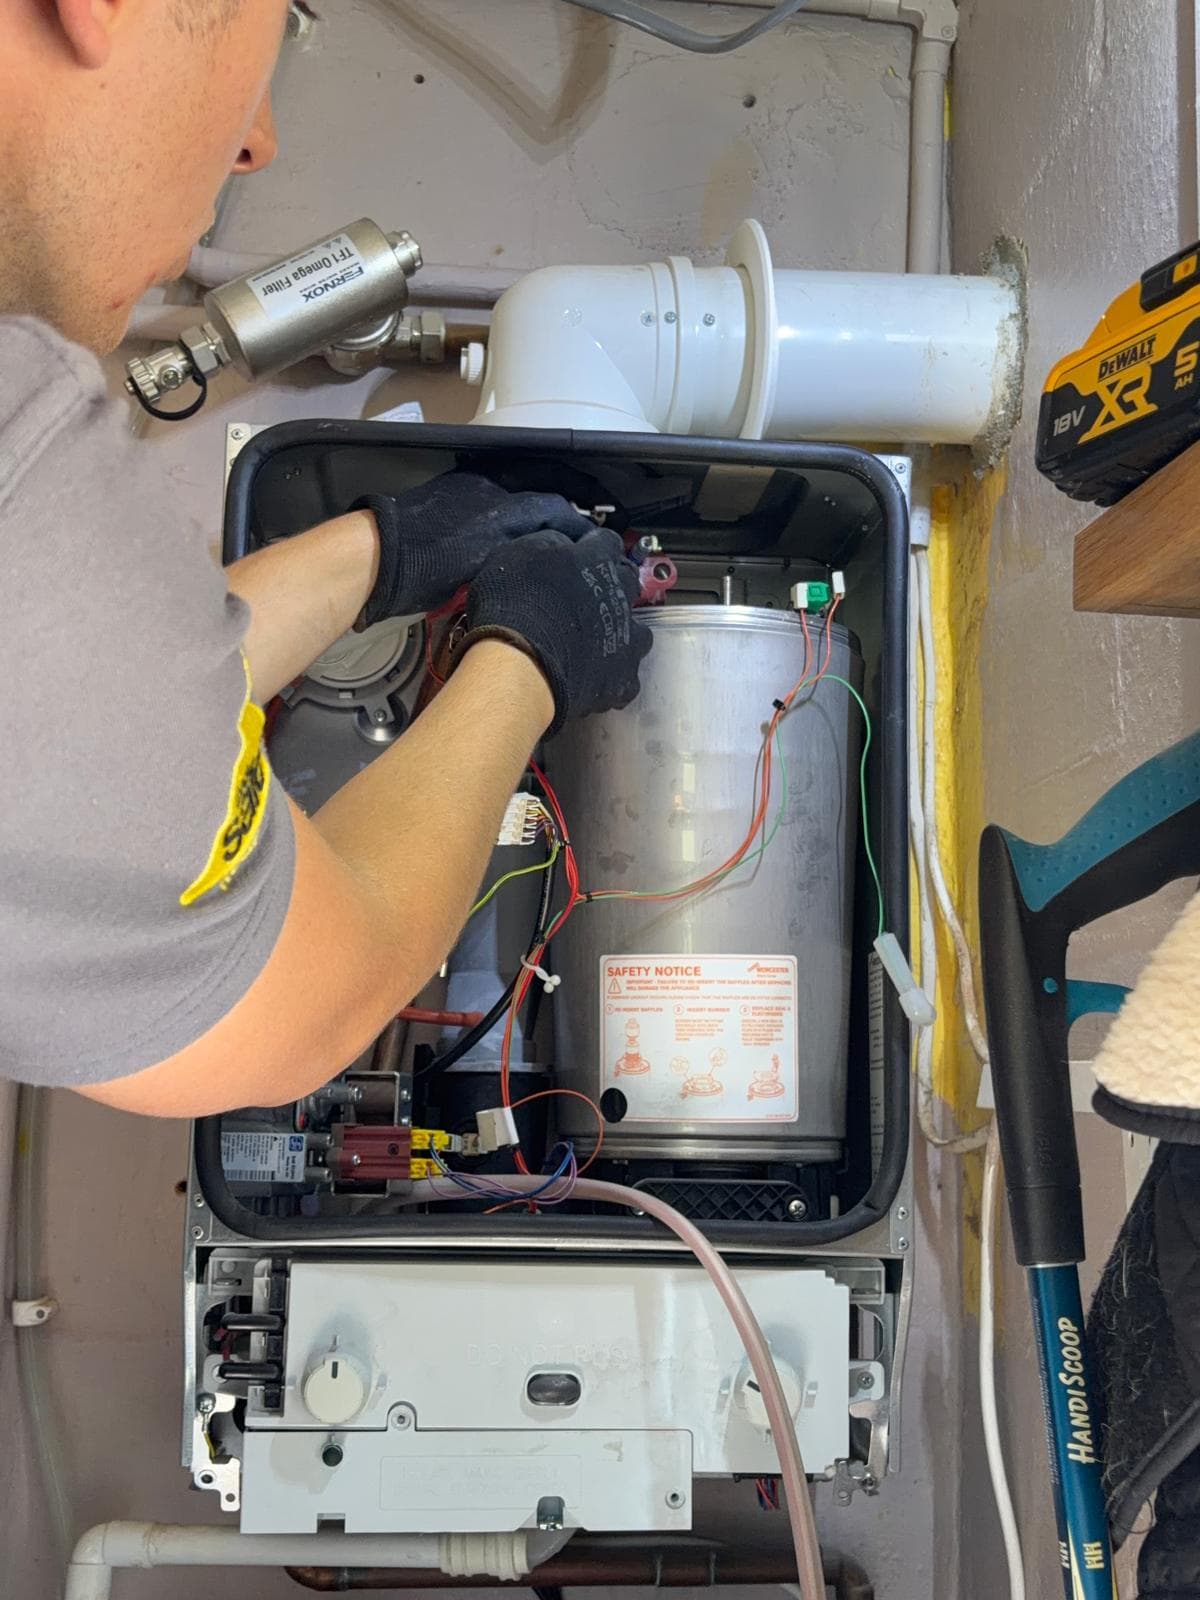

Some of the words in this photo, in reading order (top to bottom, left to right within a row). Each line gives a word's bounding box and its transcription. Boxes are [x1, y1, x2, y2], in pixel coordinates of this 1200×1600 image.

[333, 247, 355, 264] TF1
[292, 258, 333, 281] Omega
[262, 278, 293, 296] Filter
[302, 266, 364, 302] FERNOX
[1175, 341, 1200, 377] 5
[1174, 373, 1194, 391] AH
[1077, 366, 1159, 445] XR
[1052, 405, 1087, 437] 18V
[607, 966, 651, 977] SAFETY
[655, 966, 702, 977] NOTICE
